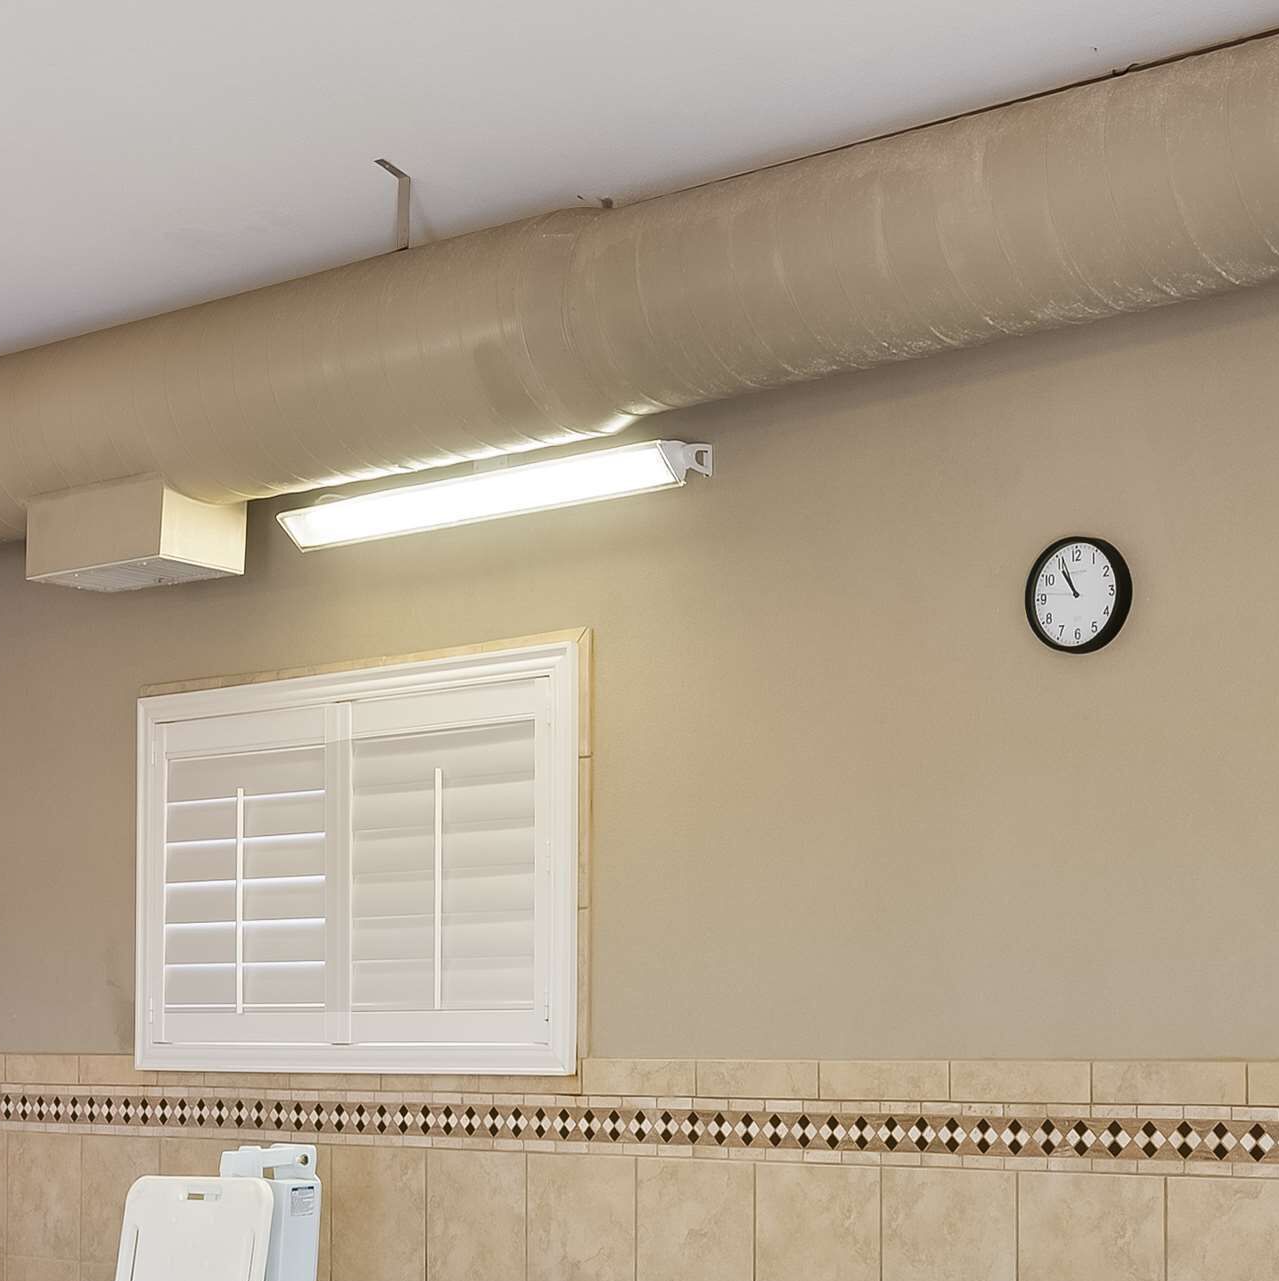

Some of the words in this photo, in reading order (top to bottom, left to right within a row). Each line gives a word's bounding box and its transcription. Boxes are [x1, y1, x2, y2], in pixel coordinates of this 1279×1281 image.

[1071, 549, 1082, 562] 12
[1102, 565, 1110, 577] 2
[1044, 574, 1055, 587] 10
[1108, 584, 1115, 596] 3
[1040, 593, 1047, 605] 9
[1103, 605, 1110, 617] 4
[1045, 612, 1053, 625] 8
[1058, 624, 1065, 638] 7
[1091, 621, 1098, 633] 5
[1074, 628, 1081, 640] 6
